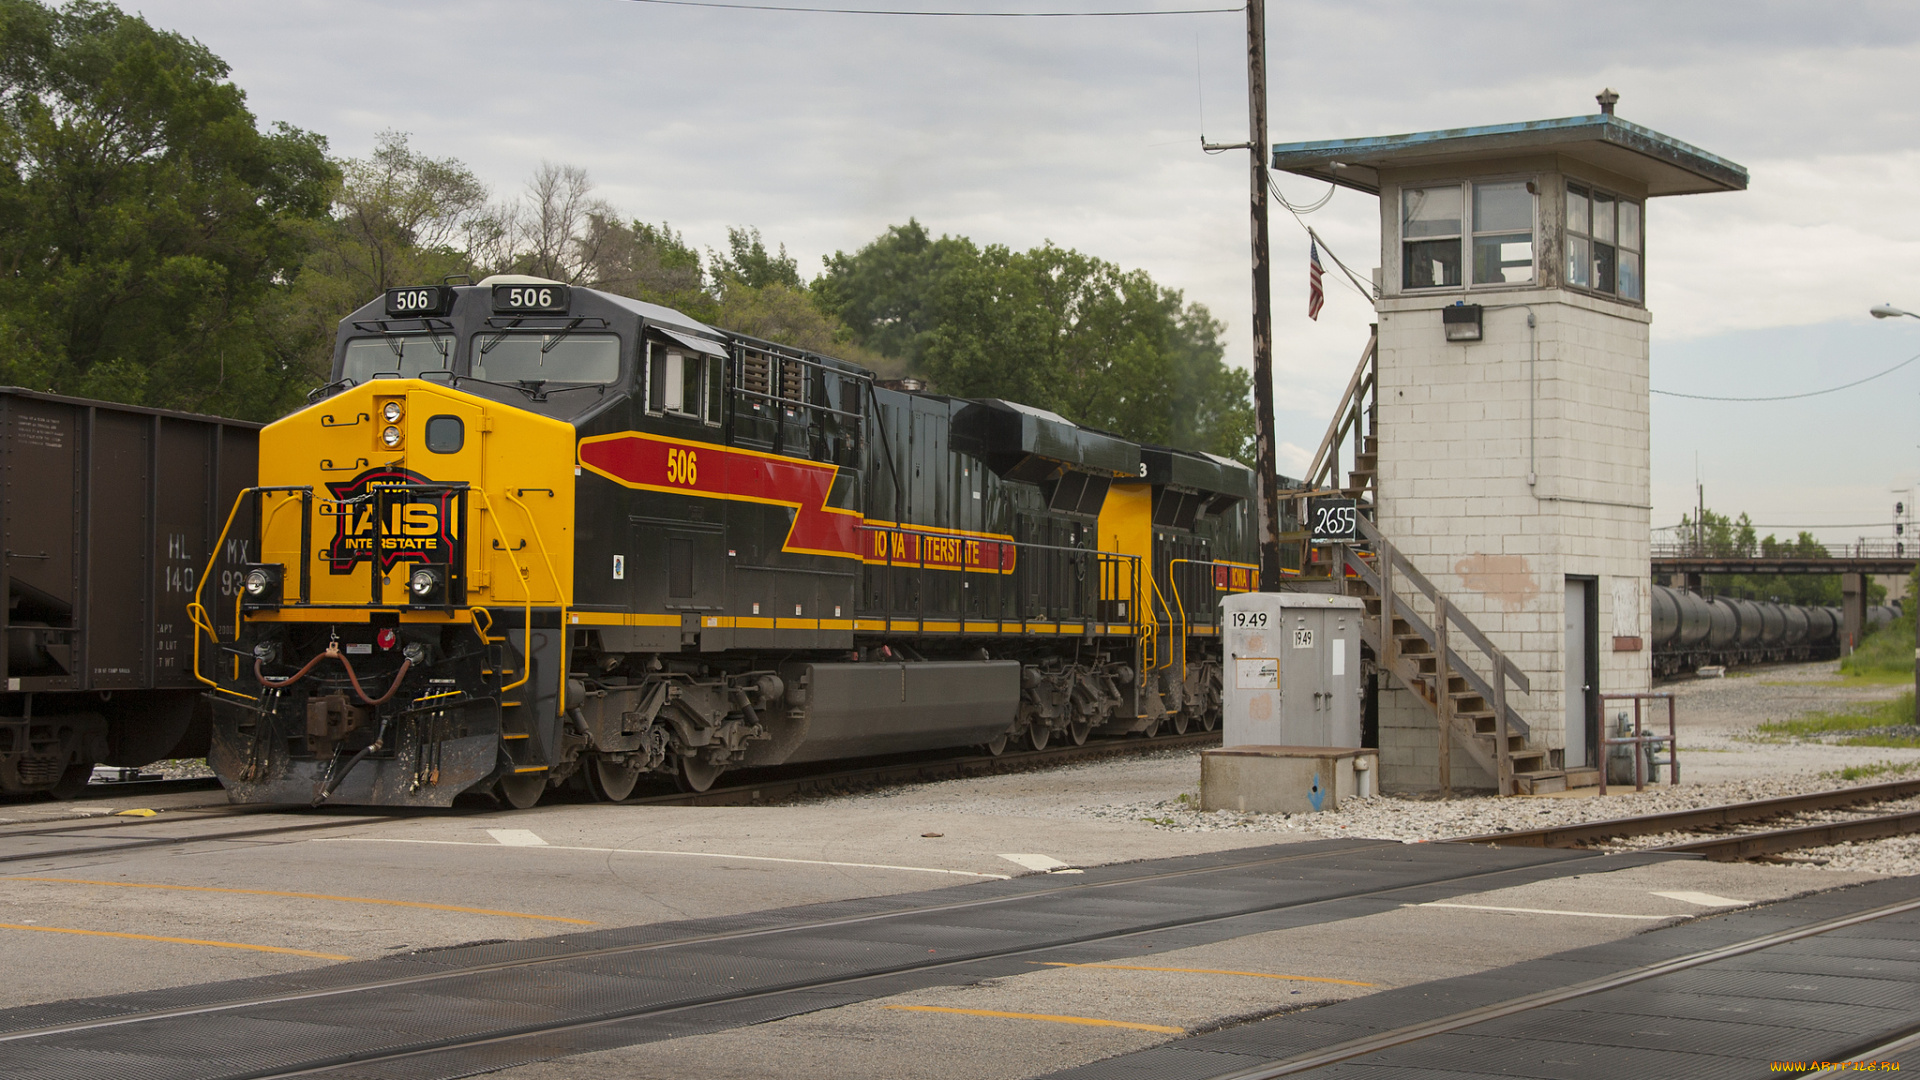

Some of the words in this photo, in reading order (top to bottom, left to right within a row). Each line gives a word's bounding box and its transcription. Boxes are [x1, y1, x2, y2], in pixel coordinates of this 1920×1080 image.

[396, 290, 428, 309] 506
[509, 288, 552, 307] 506
[667, 448, 698, 485] 506
[345, 503, 439, 536] IAIS
[1314, 507, 1355, 534] 2655
[166, 566, 194, 592] 140
[1232, 613, 1267, 628] 19.49
[1295, 631, 1312, 646] 19.49
